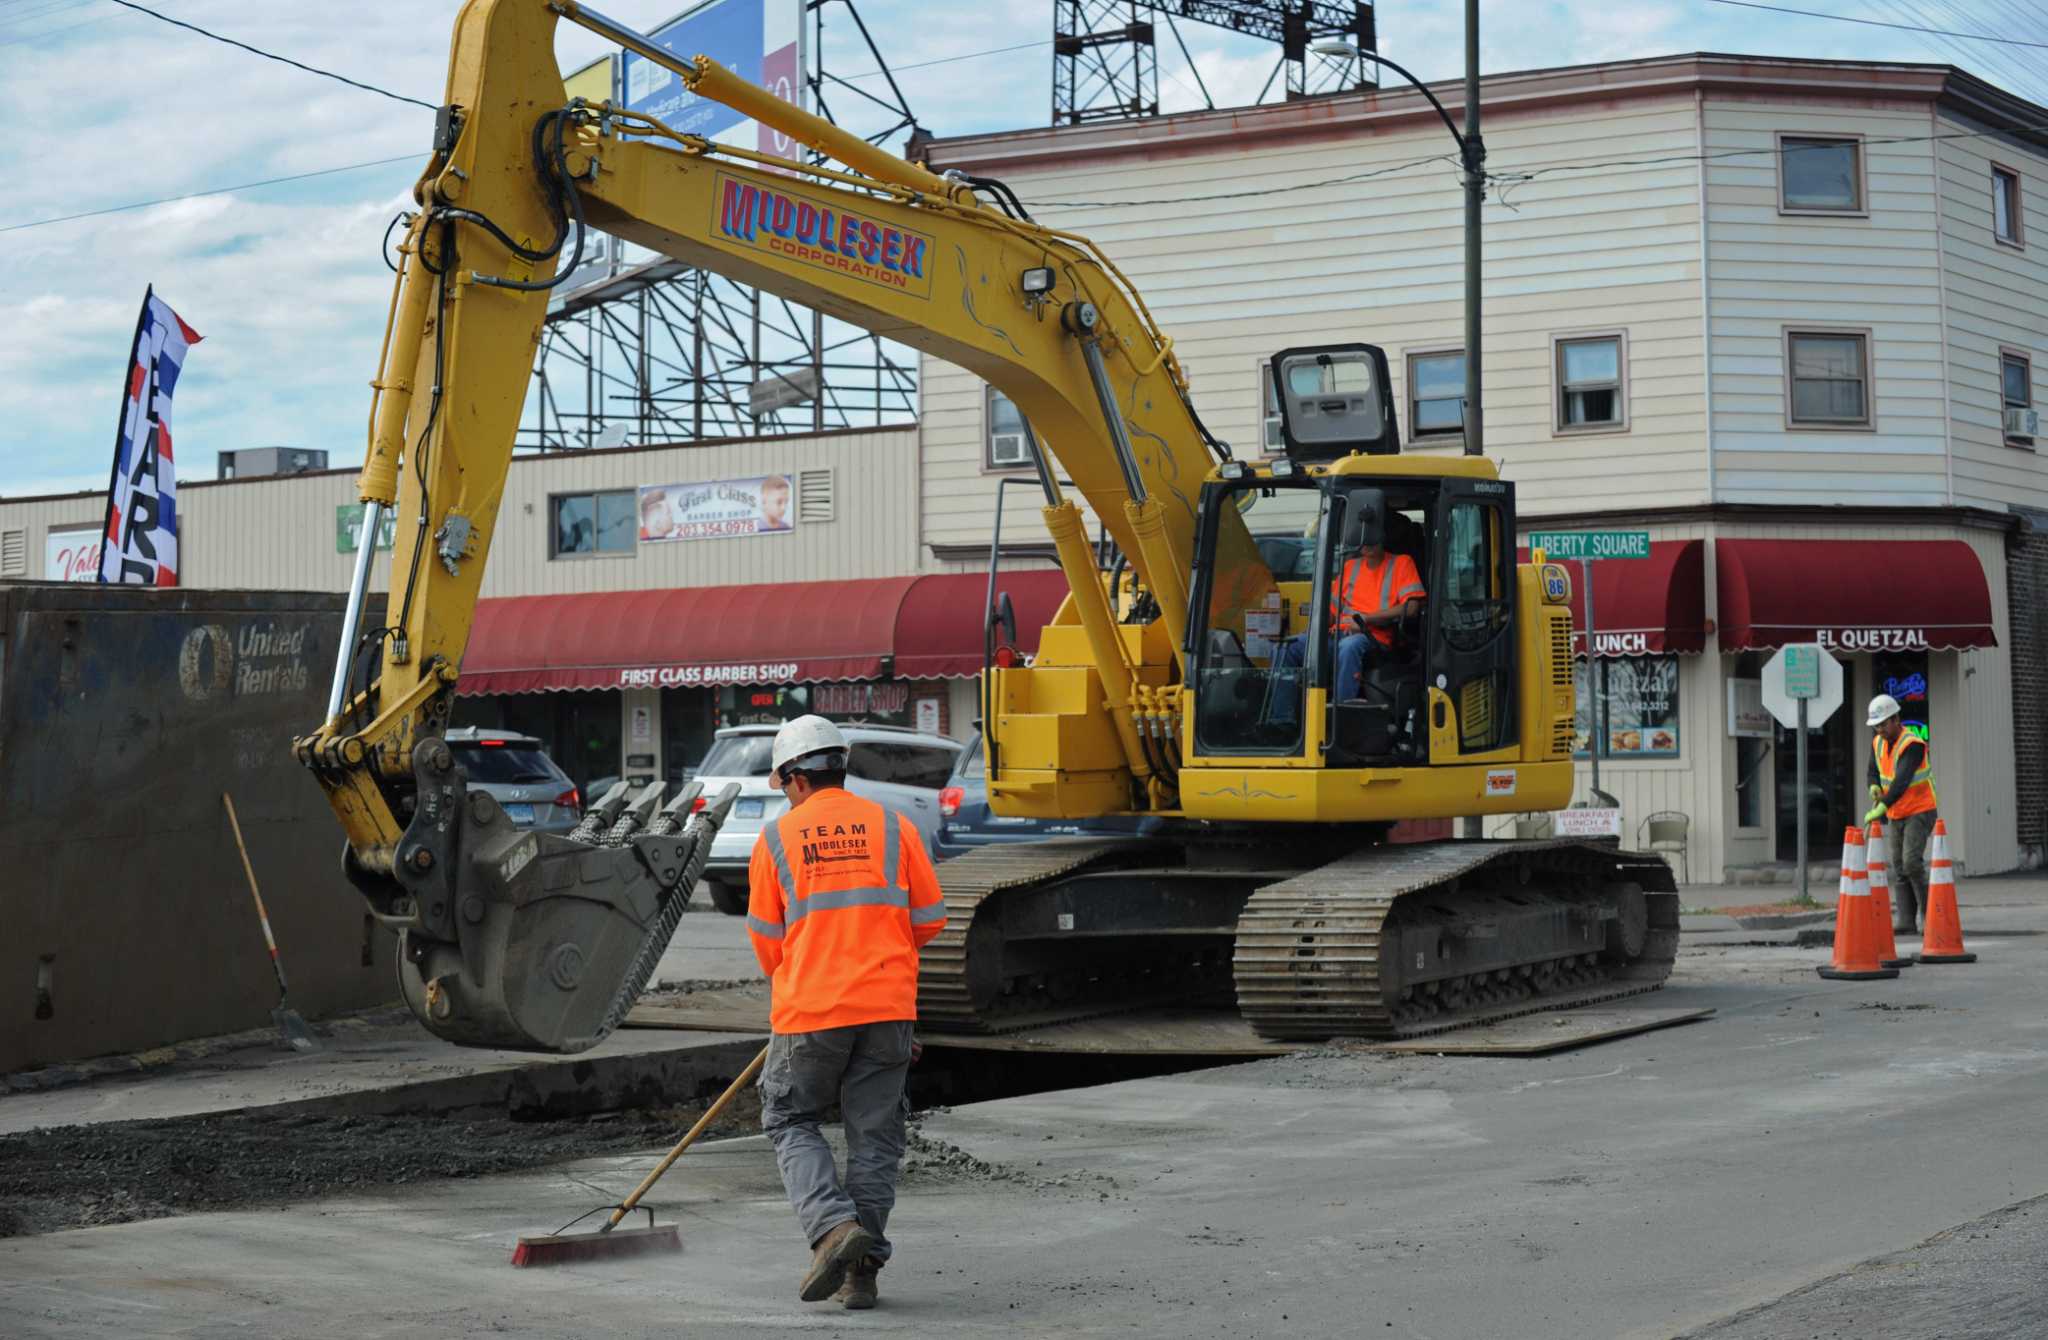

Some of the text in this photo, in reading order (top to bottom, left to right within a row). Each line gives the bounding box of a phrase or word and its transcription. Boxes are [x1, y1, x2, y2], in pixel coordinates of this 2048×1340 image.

[720, 179, 928, 278] MIDDLESEX
[769, 237, 907, 288] CORPORATION
[1531, 534, 1647, 555] LIBERTY SQUARE
[1549, 579, 1564, 594] 86
[238, 624, 307, 656] United
[1594, 633, 1647, 652] UNCH
[1816, 629, 1928, 648] EL QUETZAL
[621, 663, 798, 684] FIRST CLASS BARBER SHOP
[800, 823, 866, 839] TEAM
[802, 839, 867, 865] MIDDLESEX
